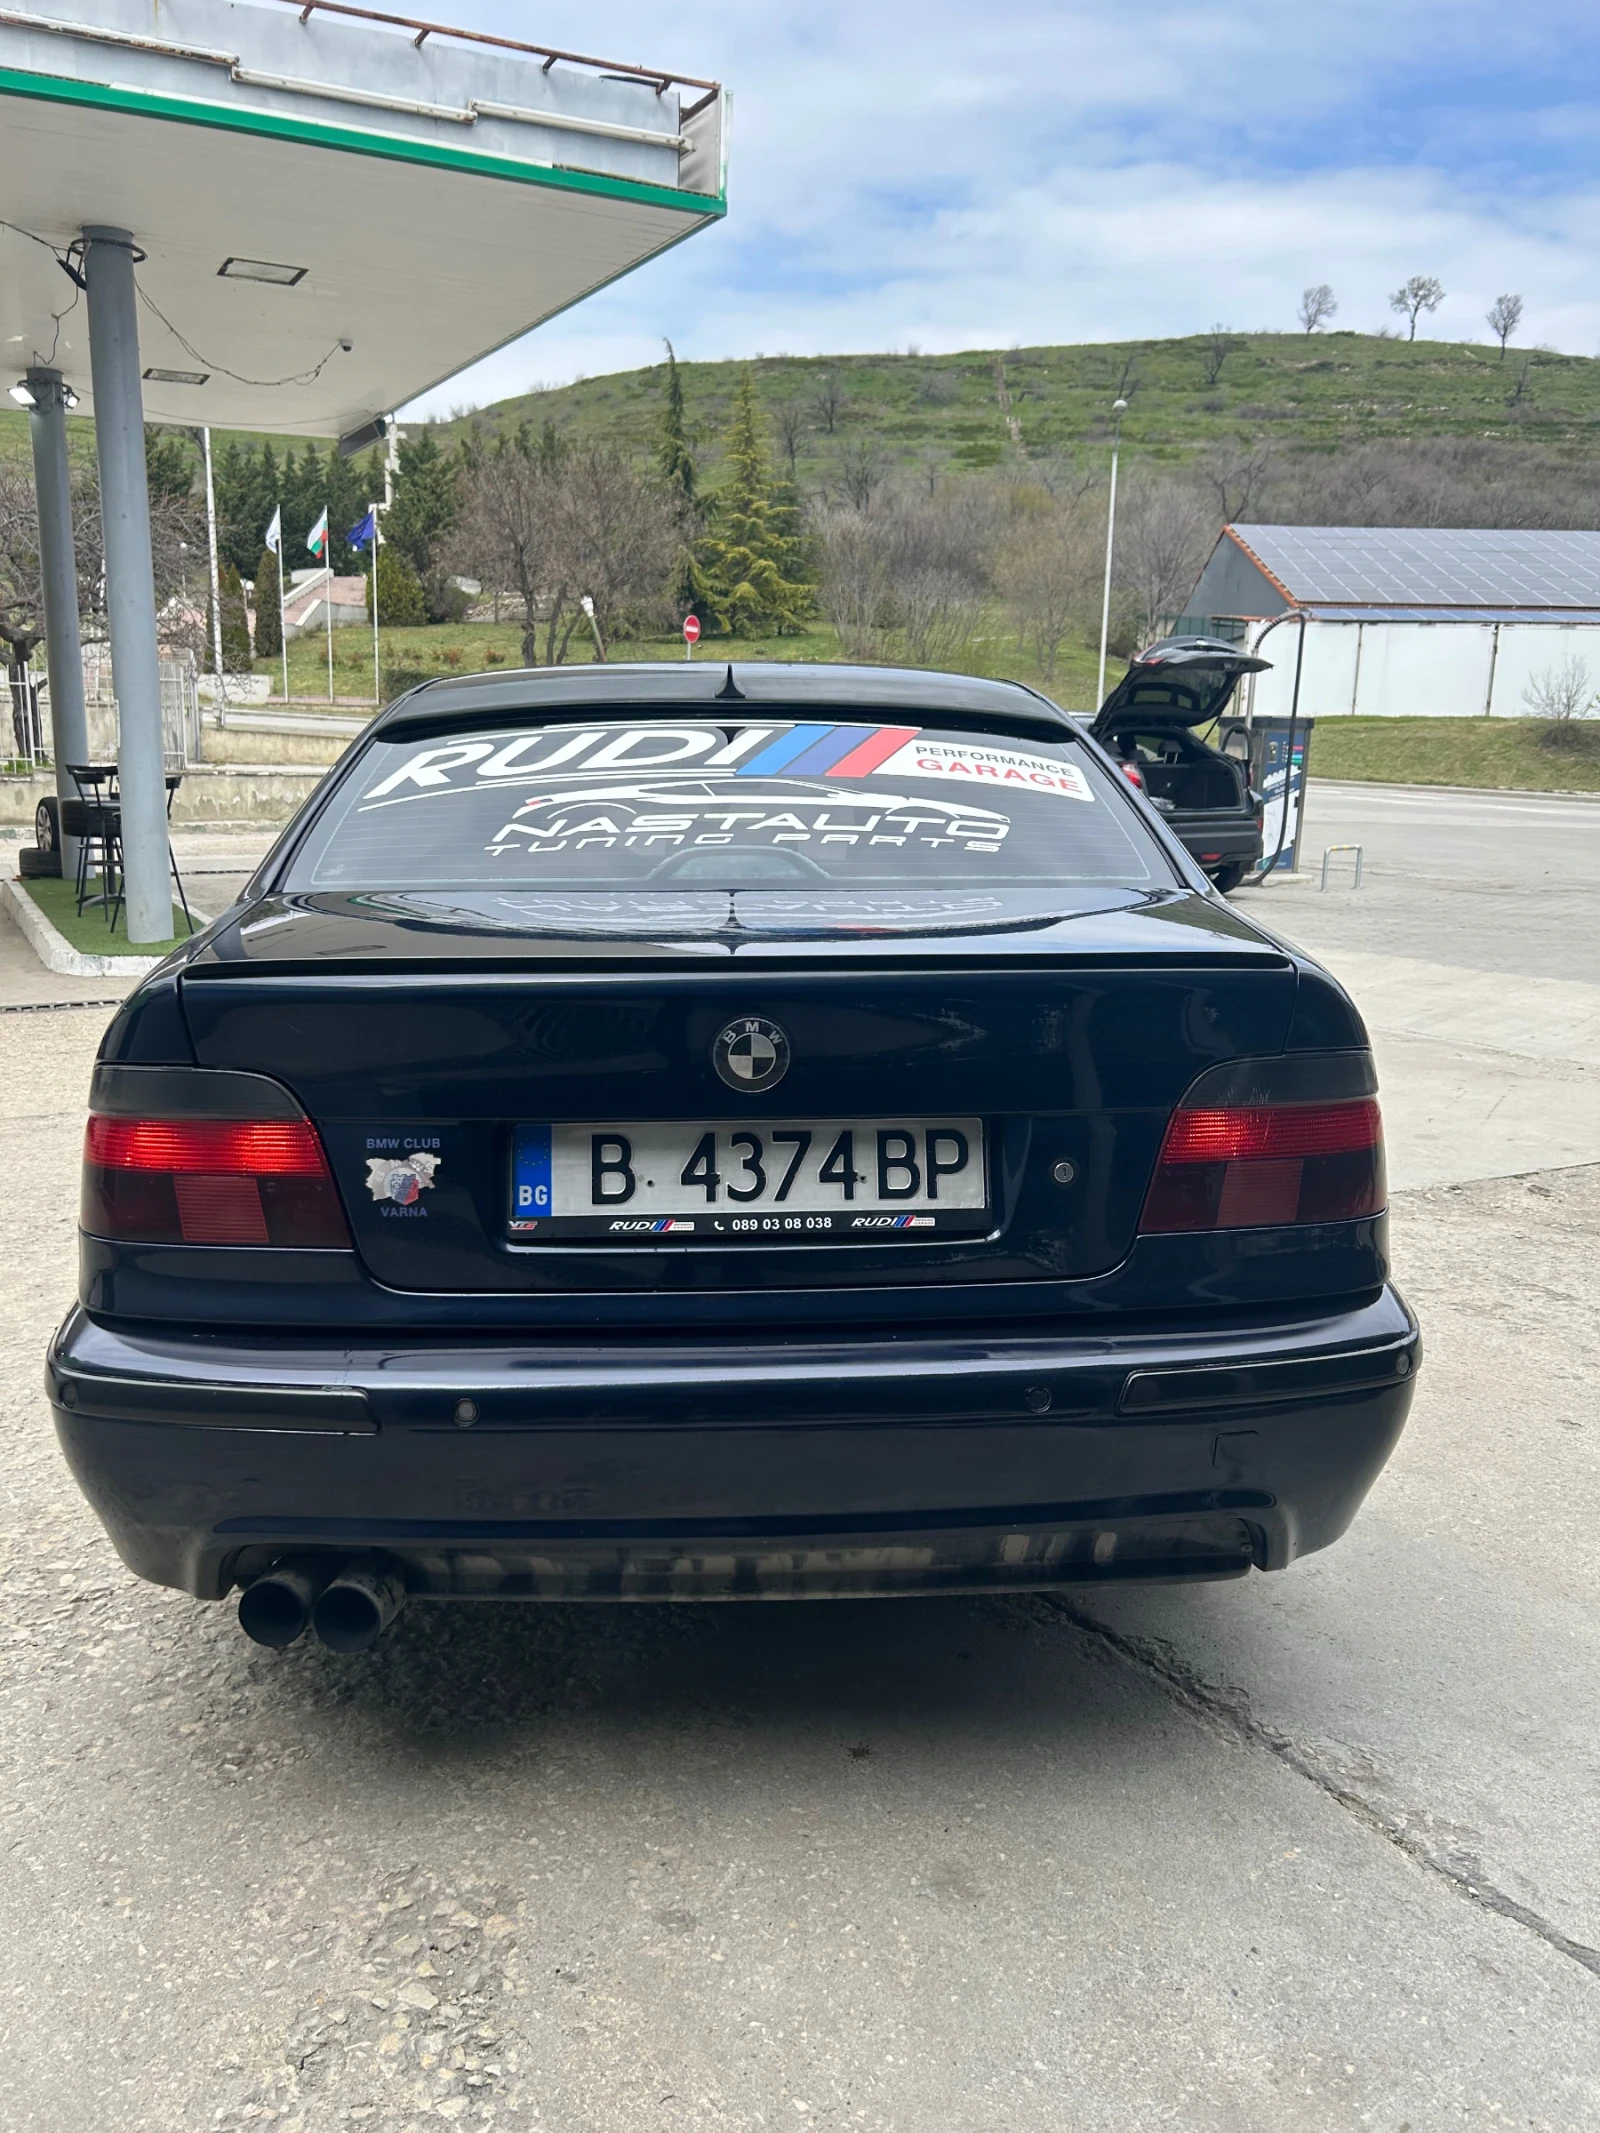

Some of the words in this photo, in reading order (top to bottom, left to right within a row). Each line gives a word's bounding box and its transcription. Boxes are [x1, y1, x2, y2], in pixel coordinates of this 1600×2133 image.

[363, 730, 774, 799] RUDI
[915, 745, 1075, 777] PERFORMANCE
[916, 758, 1083, 793] GARAGE
[492, 812, 1010, 842] NASTAUTO
[484, 833, 735, 857] TUNING
[771, 833, 1003, 853] PARTS
[722, 1020, 783, 1045] BMW
[366, 1138, 401, 1149] BMW
[403, 1138, 441, 1149] CLUB
[518, 1185, 548, 1206] BG
[591, 1133, 637, 1206] B
[680, 1130, 858, 1204] 4374
[876, 1129, 970, 1201] BP
[380, 1207, 428, 1217] VARNA
[732, 1219, 758, 1231] 089
[763, 1218, 780, 1230] 03
[784, 1218, 802, 1229] 08
[806, 1217, 832, 1229] 038
[851, 1217, 899, 1227] RUDI
[609, 1221, 658, 1230] RUDI
